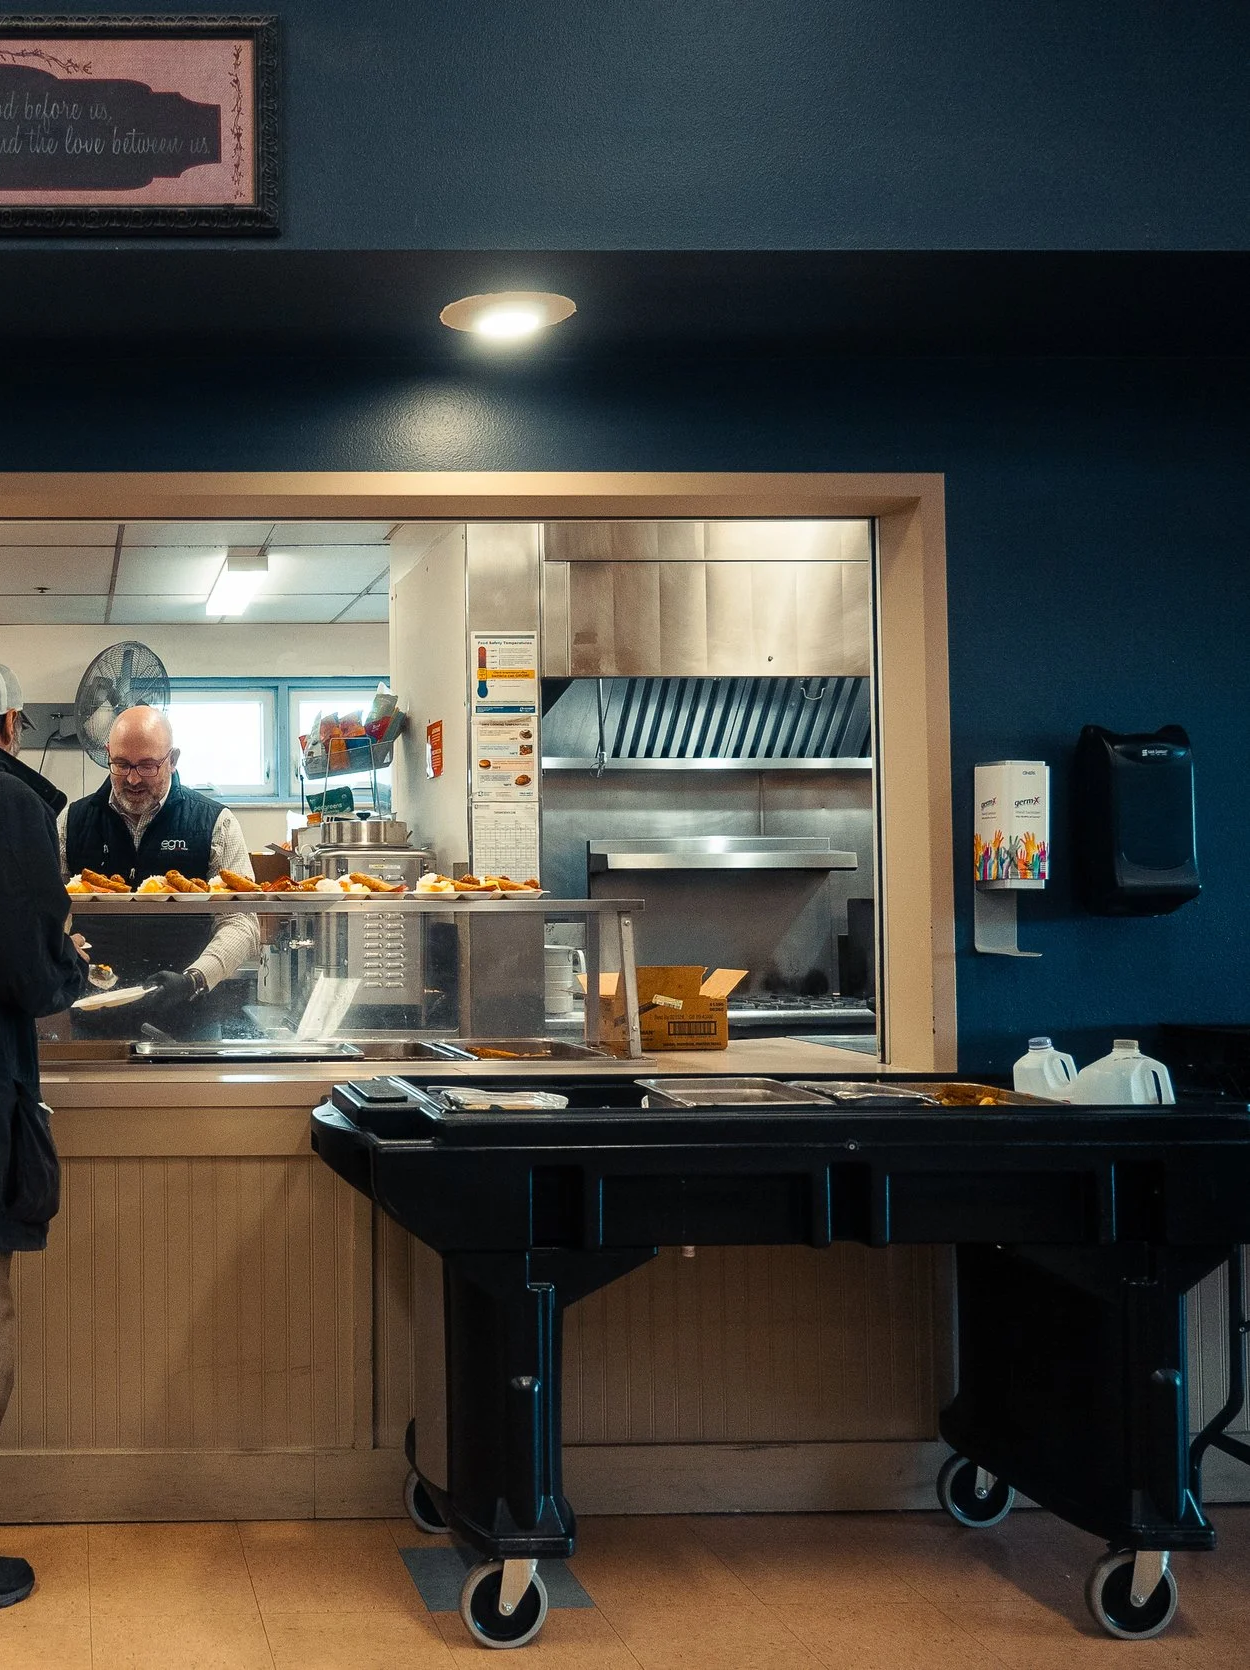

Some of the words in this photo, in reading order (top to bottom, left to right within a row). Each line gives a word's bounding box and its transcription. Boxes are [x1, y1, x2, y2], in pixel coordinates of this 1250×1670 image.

[24, 91, 83, 133] before
[89, 102, 113, 123] us,
[25, 125, 58, 154] the
[65, 125, 105, 154] love
[112, 128, 183, 154] between
[161, 840, 186, 850] egm
